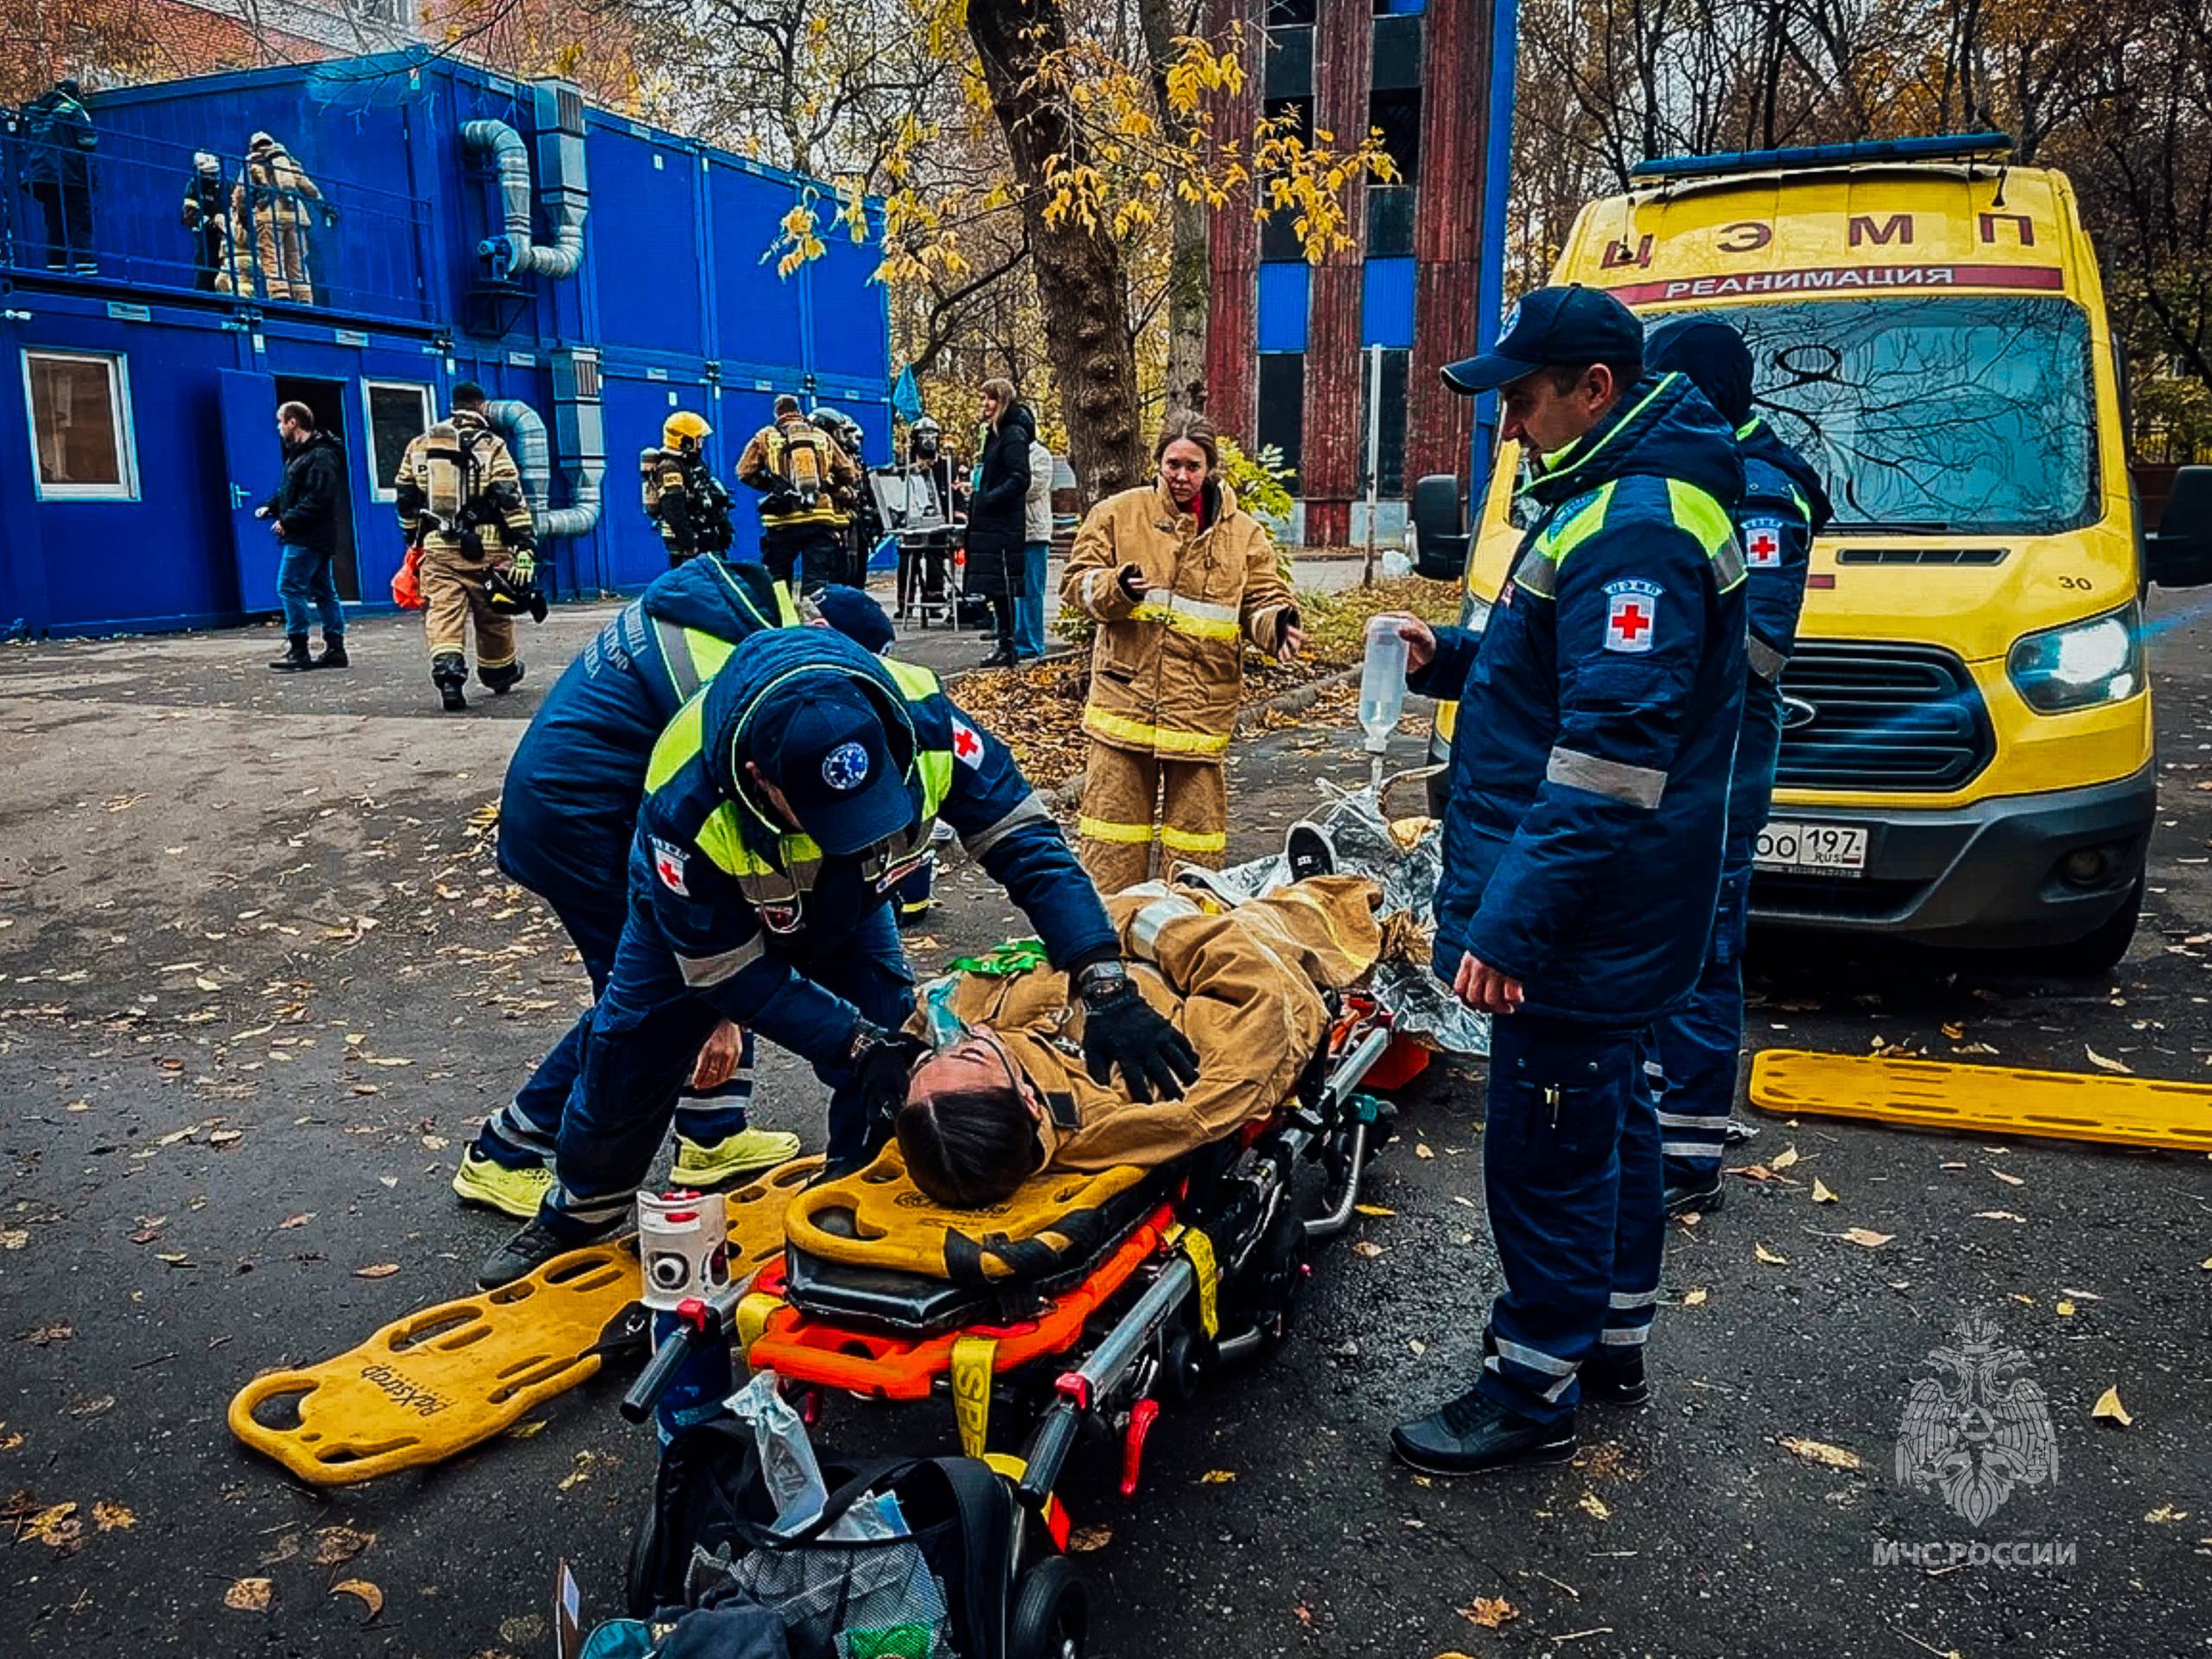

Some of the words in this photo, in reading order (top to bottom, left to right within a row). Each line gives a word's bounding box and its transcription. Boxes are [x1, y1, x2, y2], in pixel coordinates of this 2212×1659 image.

[1599, 213, 2035, 270] ЦЭМП
[1664, 267, 1955, 299] РЕАНИМАЦИЯ
[2058, 575, 2092, 590] 30
[1806, 829, 1857, 854] 197
[1815, 852, 1843, 863] RUS
